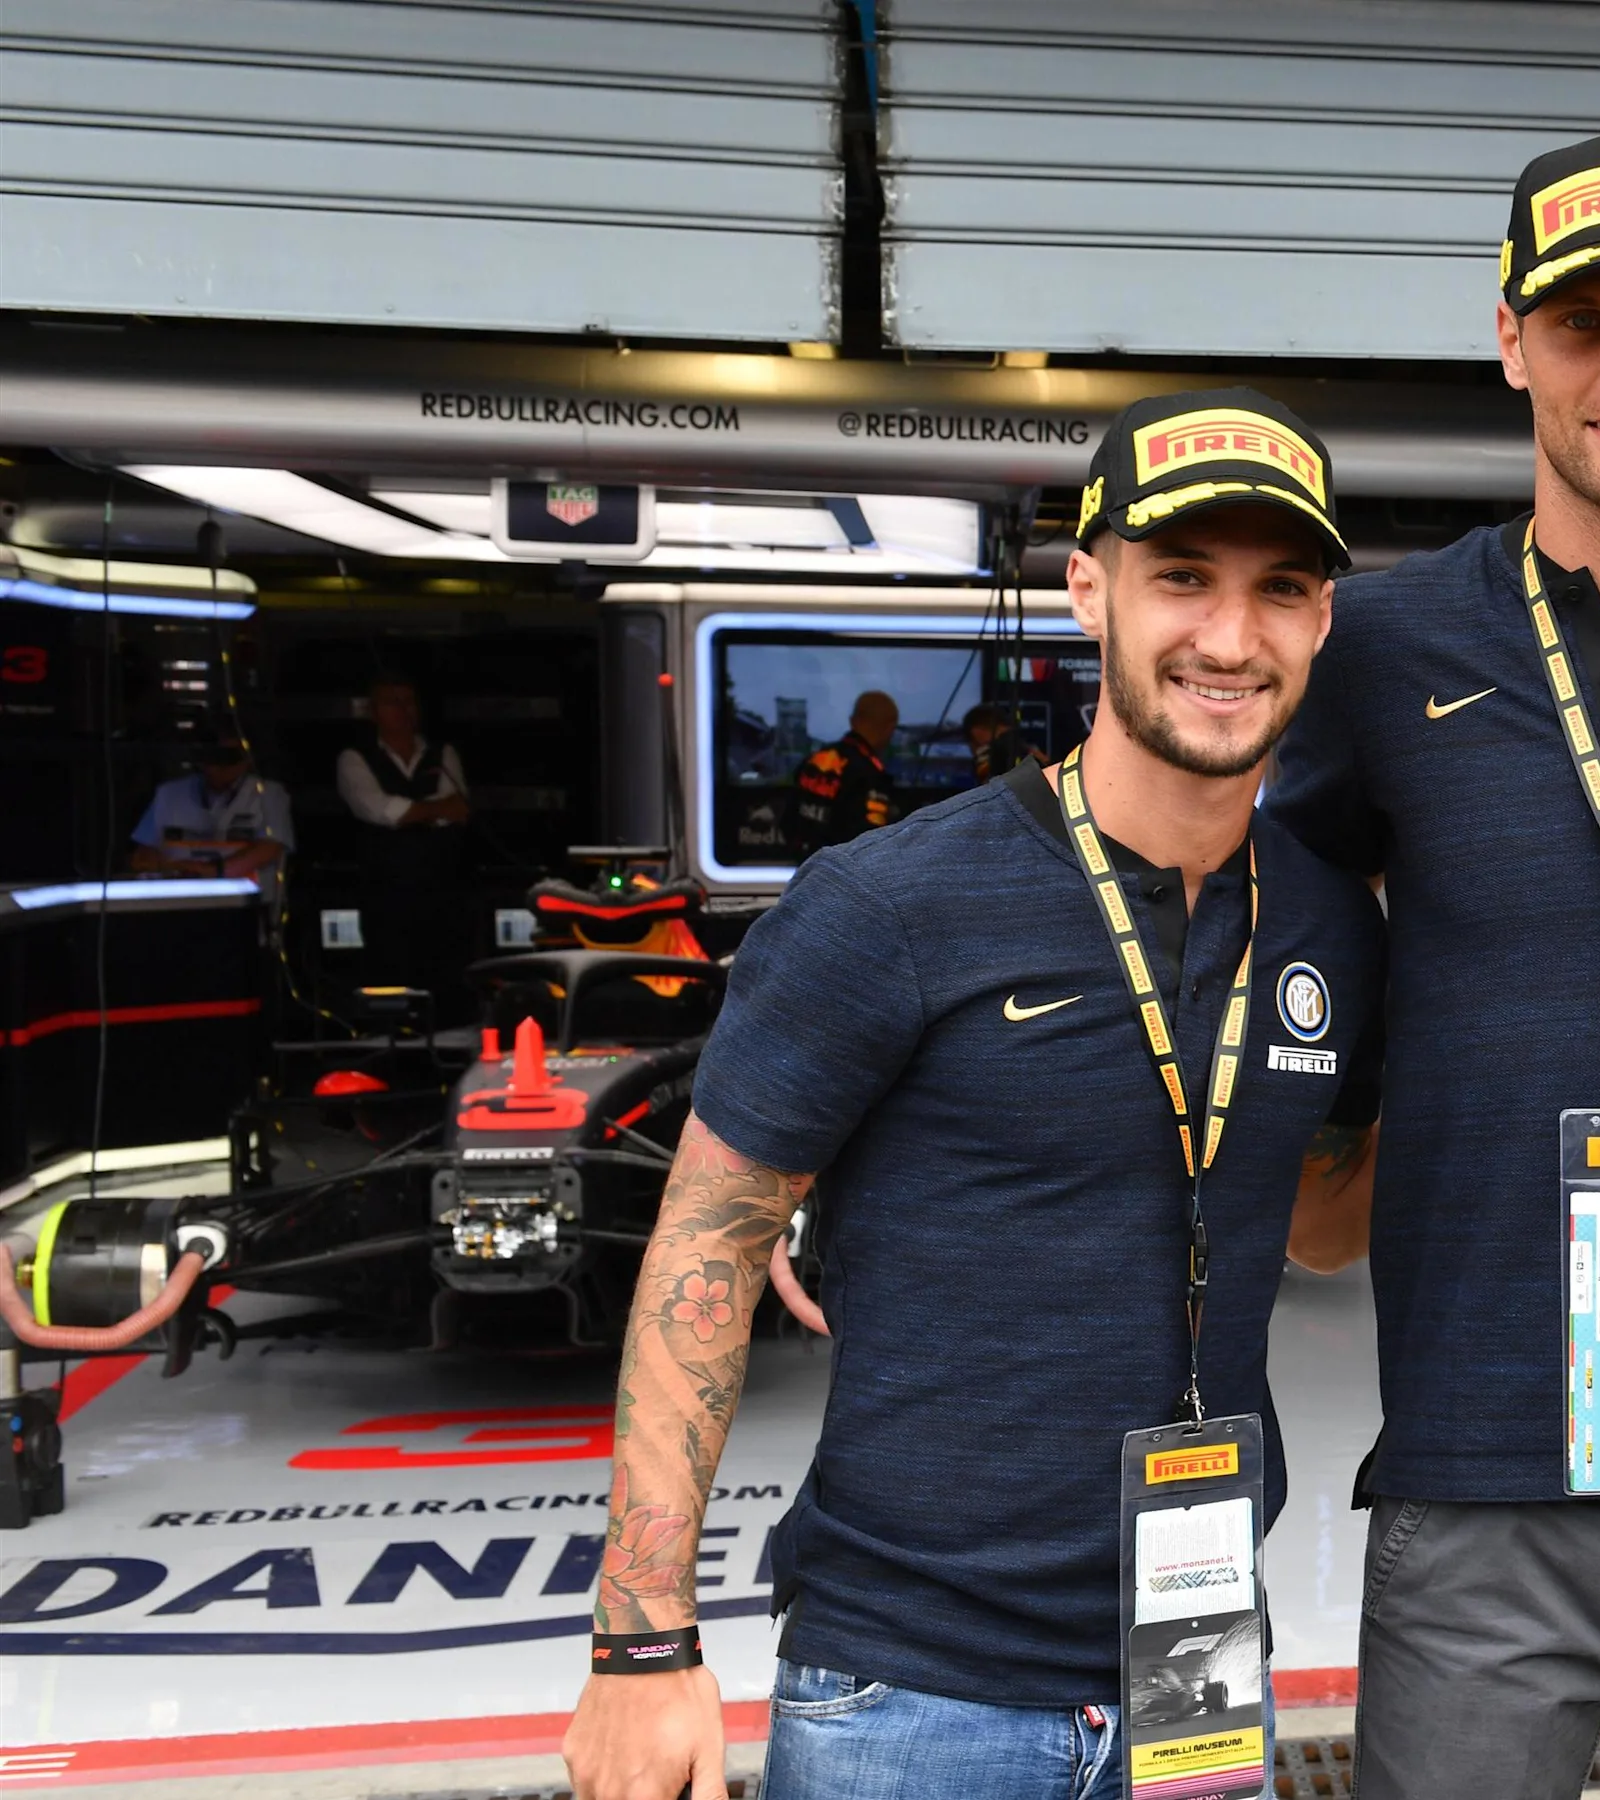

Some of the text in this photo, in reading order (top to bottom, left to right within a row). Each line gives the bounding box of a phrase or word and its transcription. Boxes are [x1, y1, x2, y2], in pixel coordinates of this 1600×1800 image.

[421, 393, 741, 431] REDBULLRACING.COM
[837, 411, 1090, 445] @REDBULLRACING
[1147, 421, 1317, 488] PIRELLI
[549, 484, 593, 500] TAG
[1079, 827, 1104, 869] PIRELLI
[1104, 885, 1127, 928] PIRELLI
[1126, 944, 1148, 988] PIRELLI
[1146, 1006, 1166, 1050] PIRELLI
[1267, 1045, 1338, 1075] PIRELLI
[1154, 1451, 1230, 1478] PIRELLI
[1154, 1554, 1234, 1574] www.monzanet.it
[626, 1643, 680, 1655] SUNDAY
[633, 1650, 675, 1660] HOSPITALITY
[1152, 1737, 1243, 1759] PIRELLI MUSEUM
